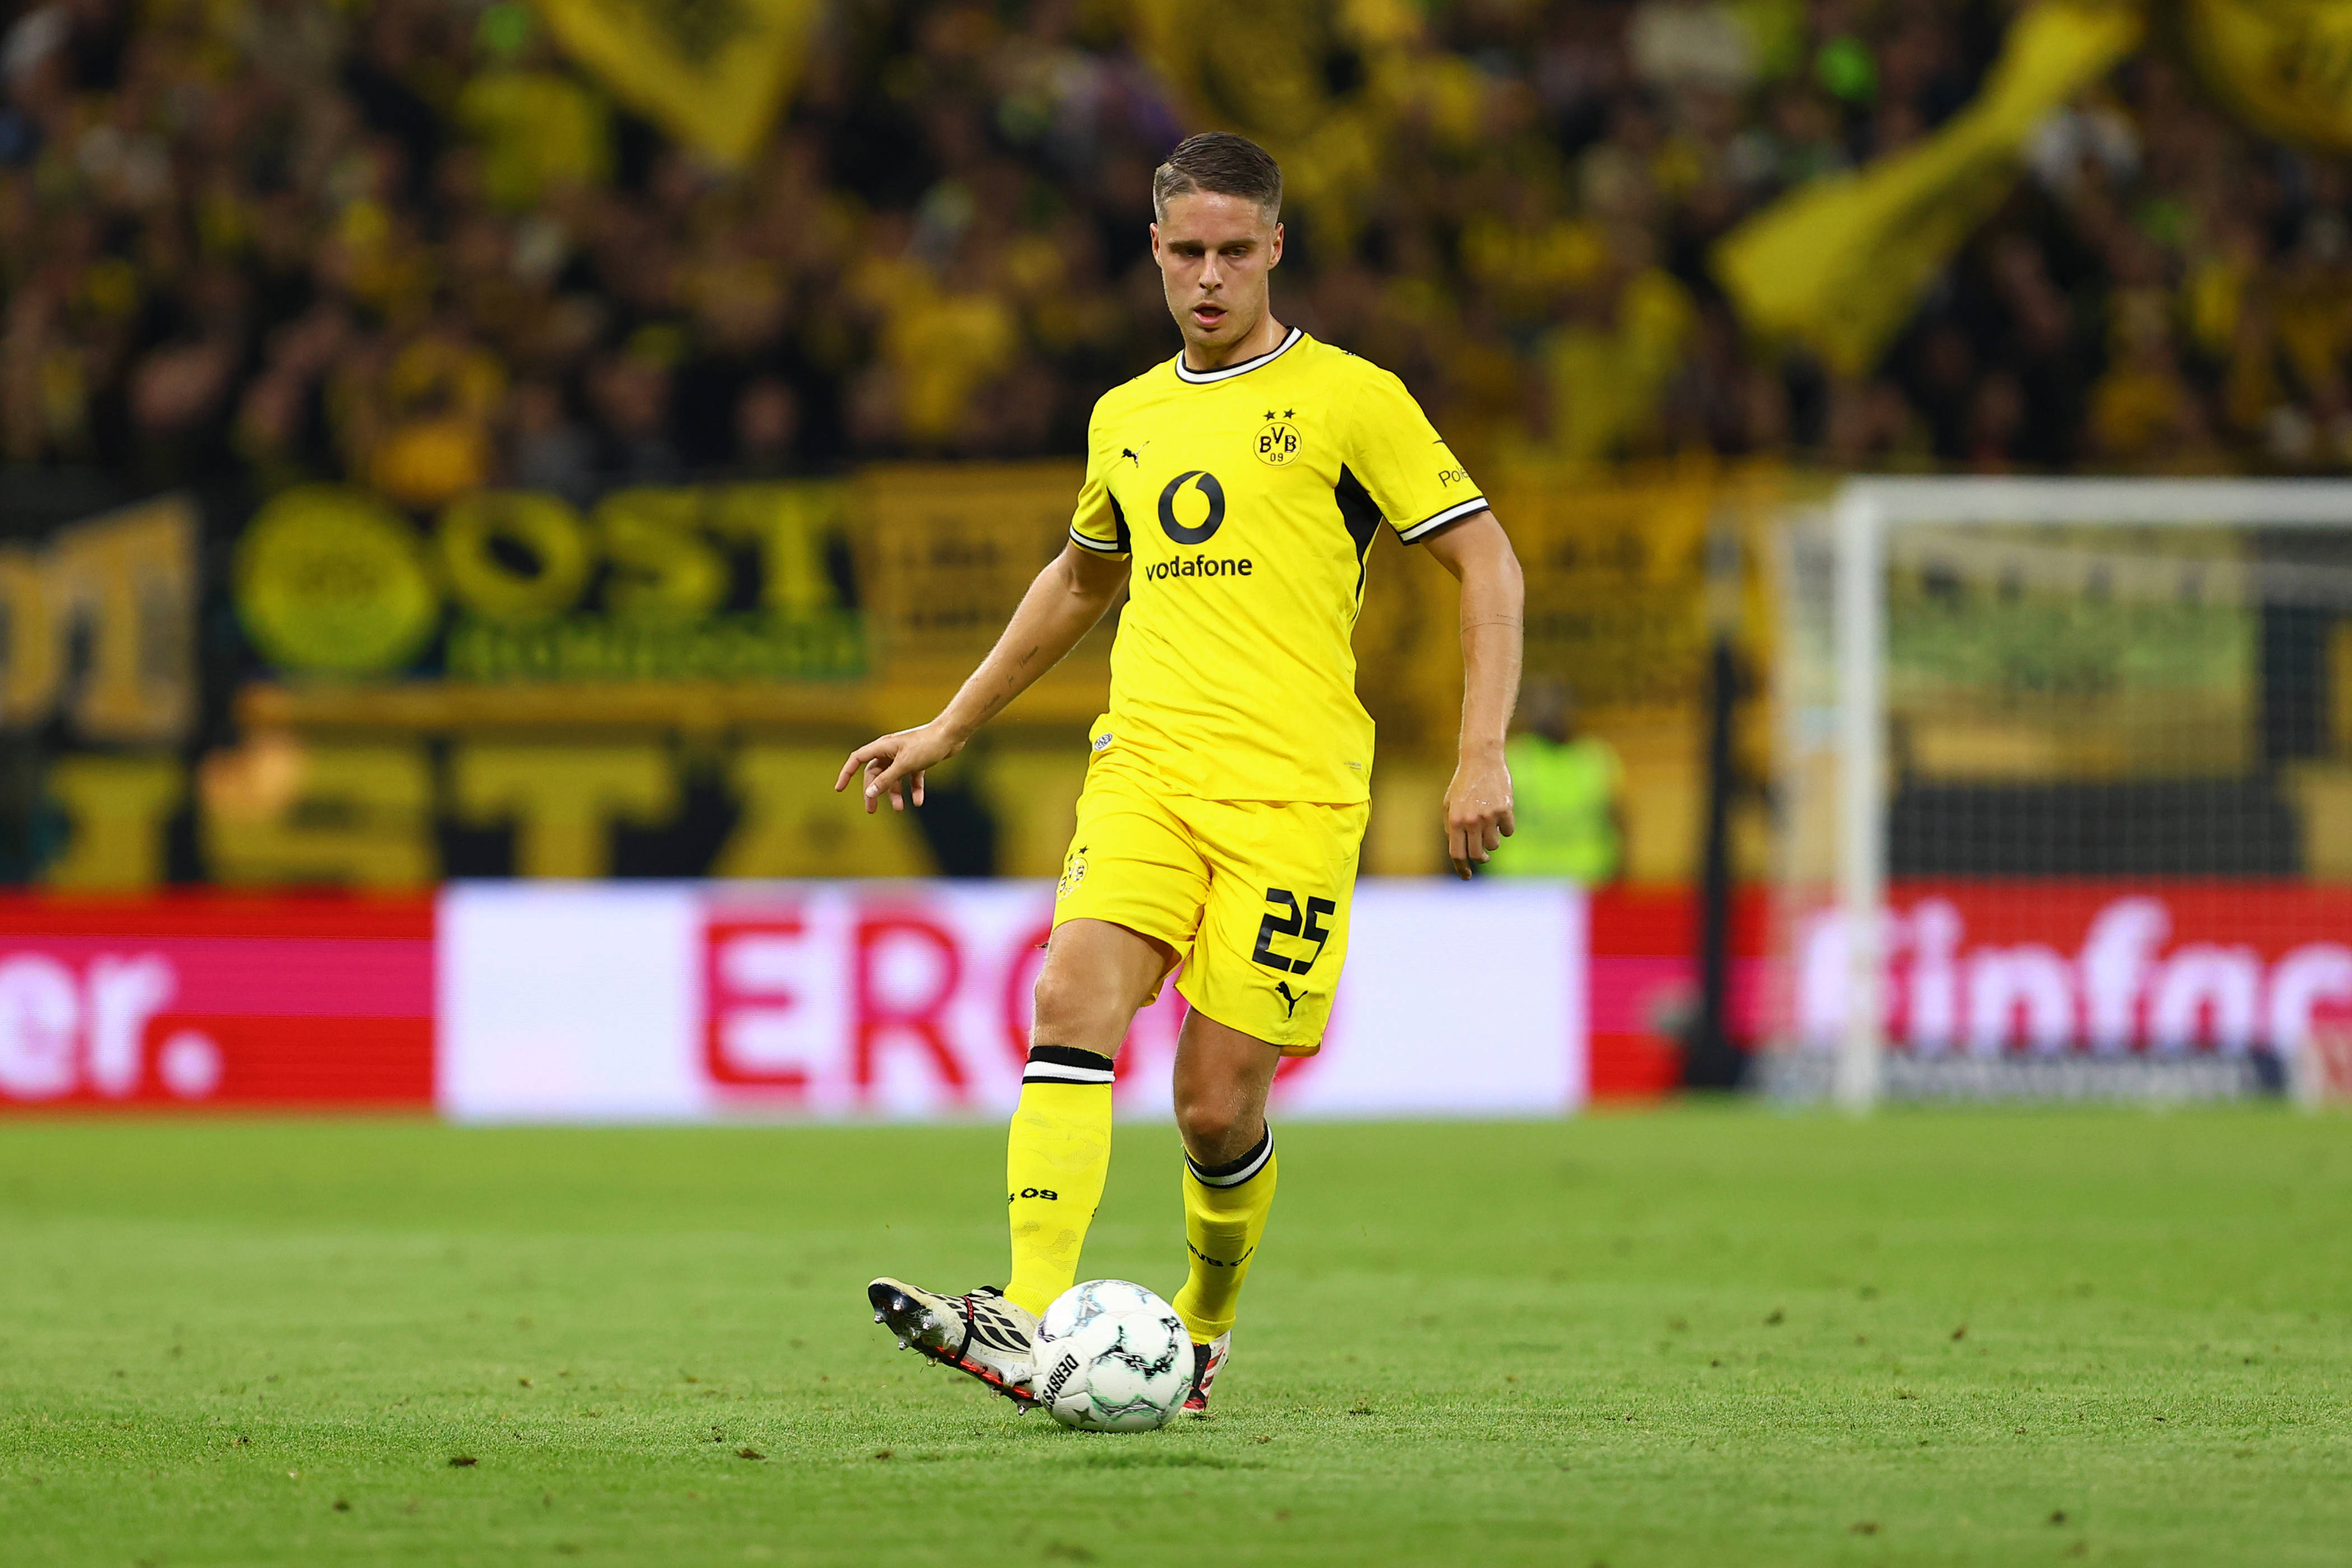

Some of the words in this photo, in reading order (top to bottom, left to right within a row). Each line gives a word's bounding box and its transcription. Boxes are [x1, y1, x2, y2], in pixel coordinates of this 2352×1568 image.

[1259, 426, 1297, 453] BVB
[1270, 452, 1284, 462] 09
[1438, 465, 1471, 488] Pole
[1145, 554, 1253, 581] vodafone
[1252, 888, 1336, 976] 25
[1020, 1188, 1058, 1201] 09
